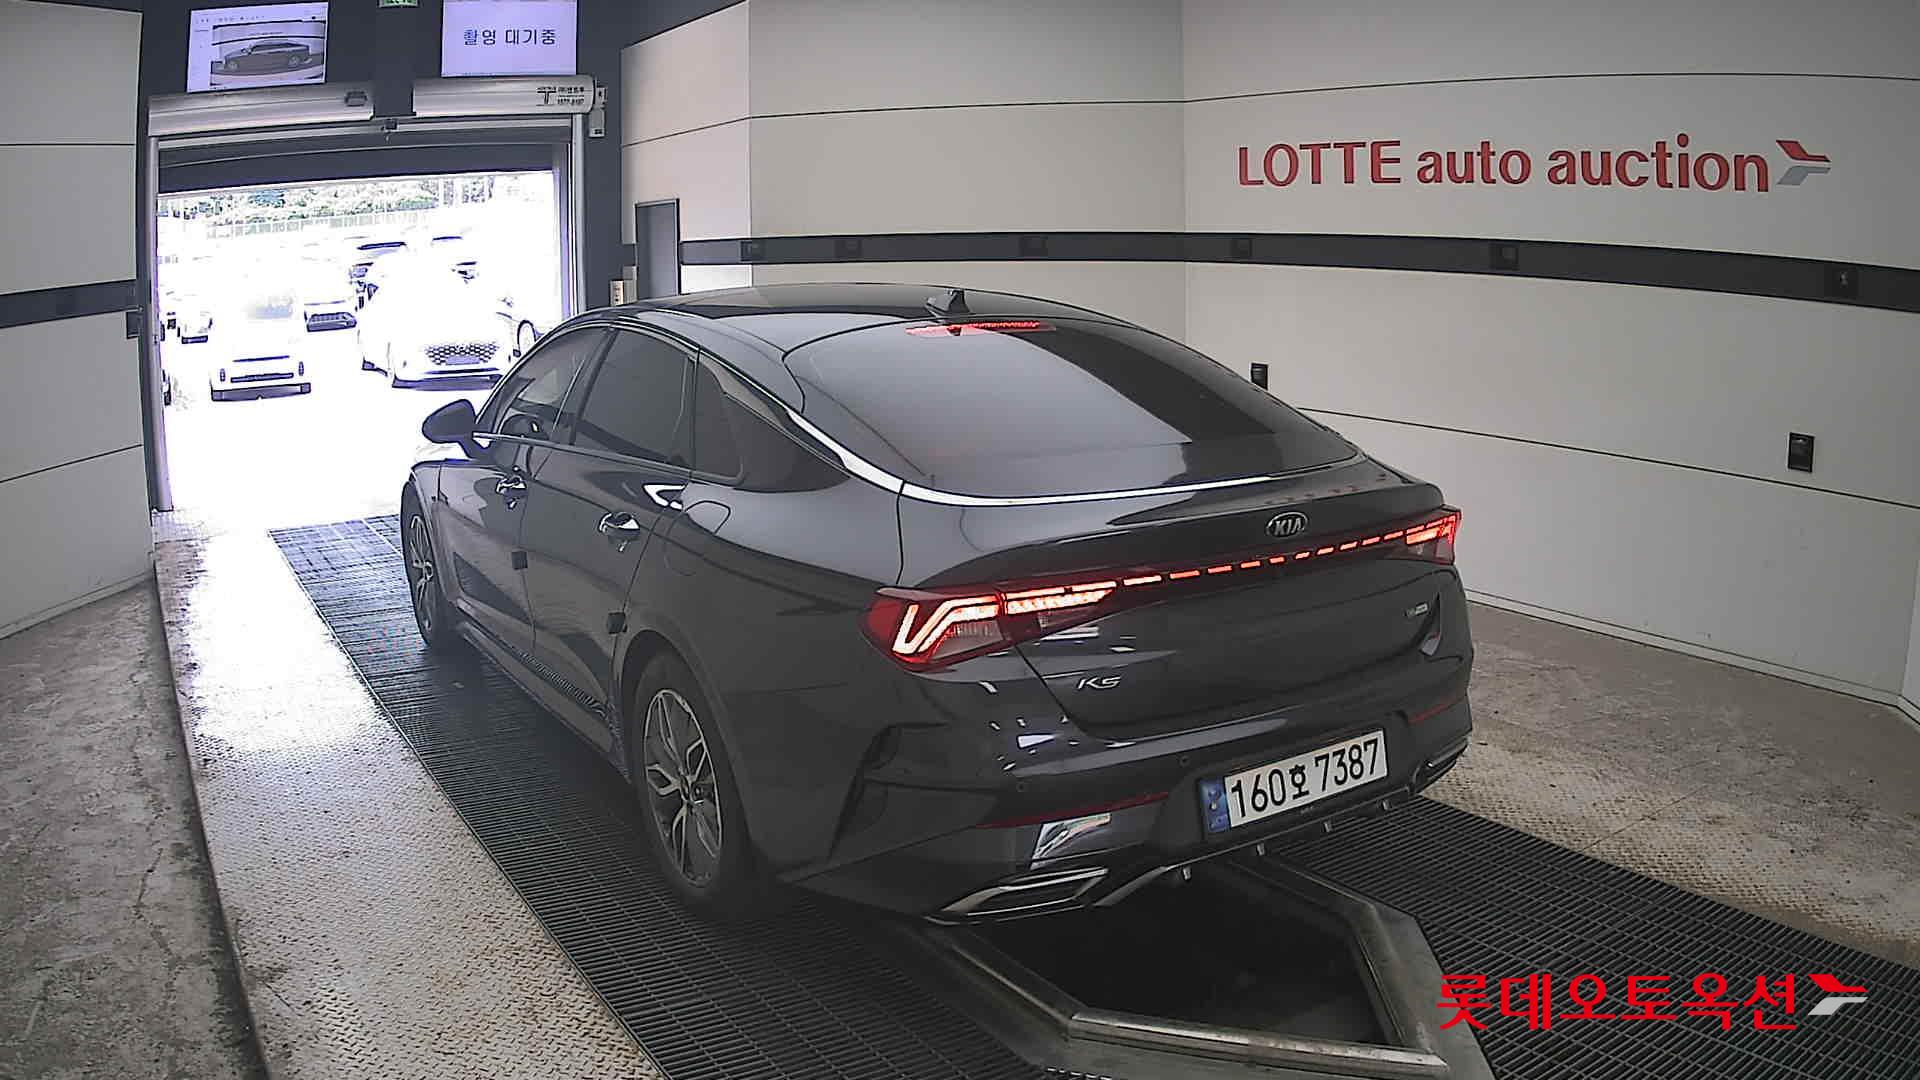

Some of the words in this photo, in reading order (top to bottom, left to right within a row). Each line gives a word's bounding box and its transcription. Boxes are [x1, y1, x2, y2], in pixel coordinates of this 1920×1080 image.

[504, 28, 556, 46] 대기중
[1238, 140, 1401, 187] LOTTE
[1416, 141, 1532, 186] auto
[1547, 133, 1769, 193] auction
[1273, 516, 1306, 537] KIA
[1077, 675, 1122, 690] K5
[1230, 763, 1311, 819] 160호
[1314, 737, 1379, 793] 7387
